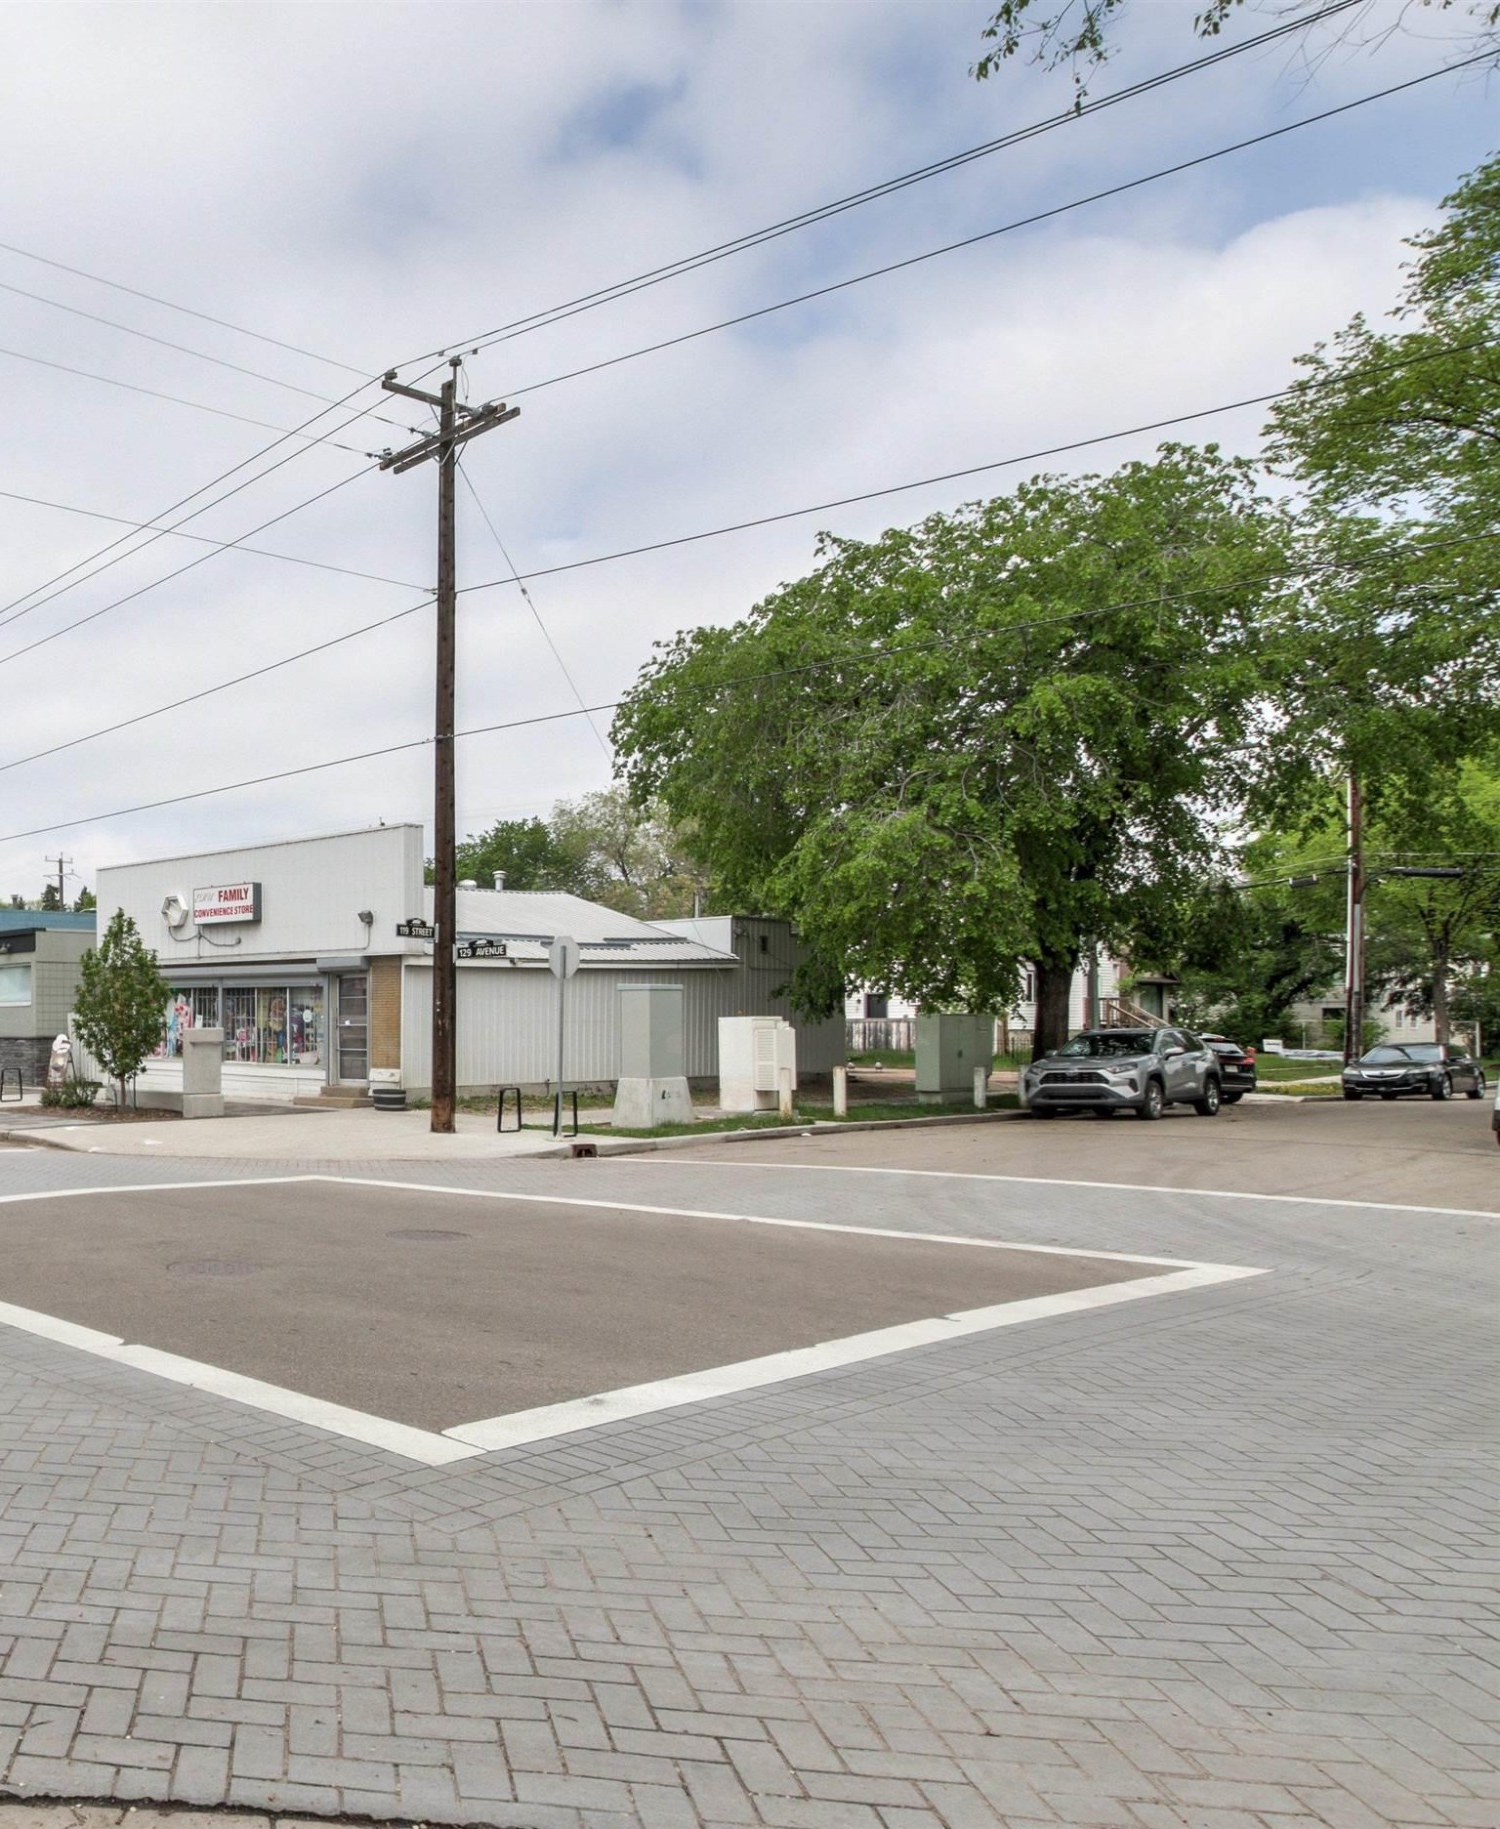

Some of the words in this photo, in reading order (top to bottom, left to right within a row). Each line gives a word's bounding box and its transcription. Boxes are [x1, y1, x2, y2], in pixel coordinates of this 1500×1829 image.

[218, 888, 249, 902] FAMILY
[194, 907, 234, 918] CONVENIENCE
[234, 904, 253, 915] STORE
[399, 926, 409, 935] 119
[411, 927, 433, 937] STREET
[459, 948, 472, 957] 129
[475, 945, 505, 956] AVENUE
